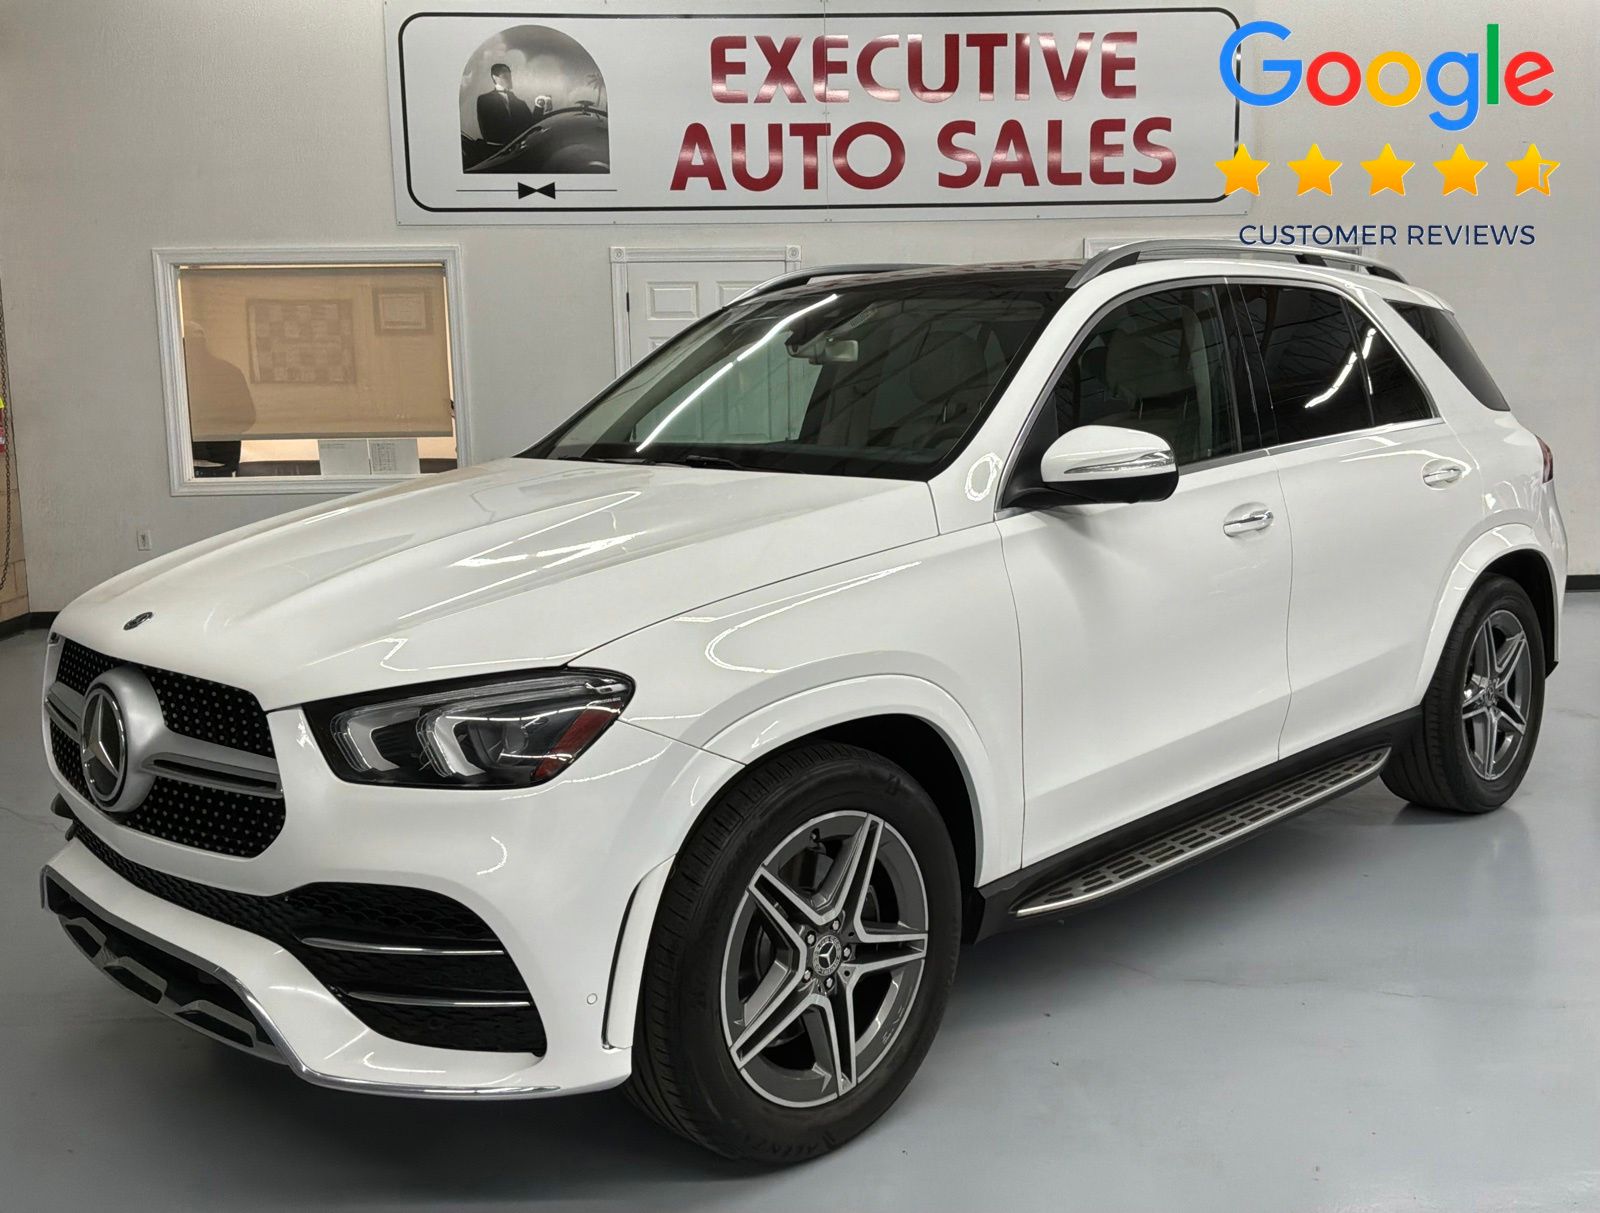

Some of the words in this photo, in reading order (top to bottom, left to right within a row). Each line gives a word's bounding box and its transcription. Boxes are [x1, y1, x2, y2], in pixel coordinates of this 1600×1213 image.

[710, 31, 1138, 104] EXECUTIVE
[669, 121, 906, 192] AUTO
[936, 116, 1177, 190] SALES
